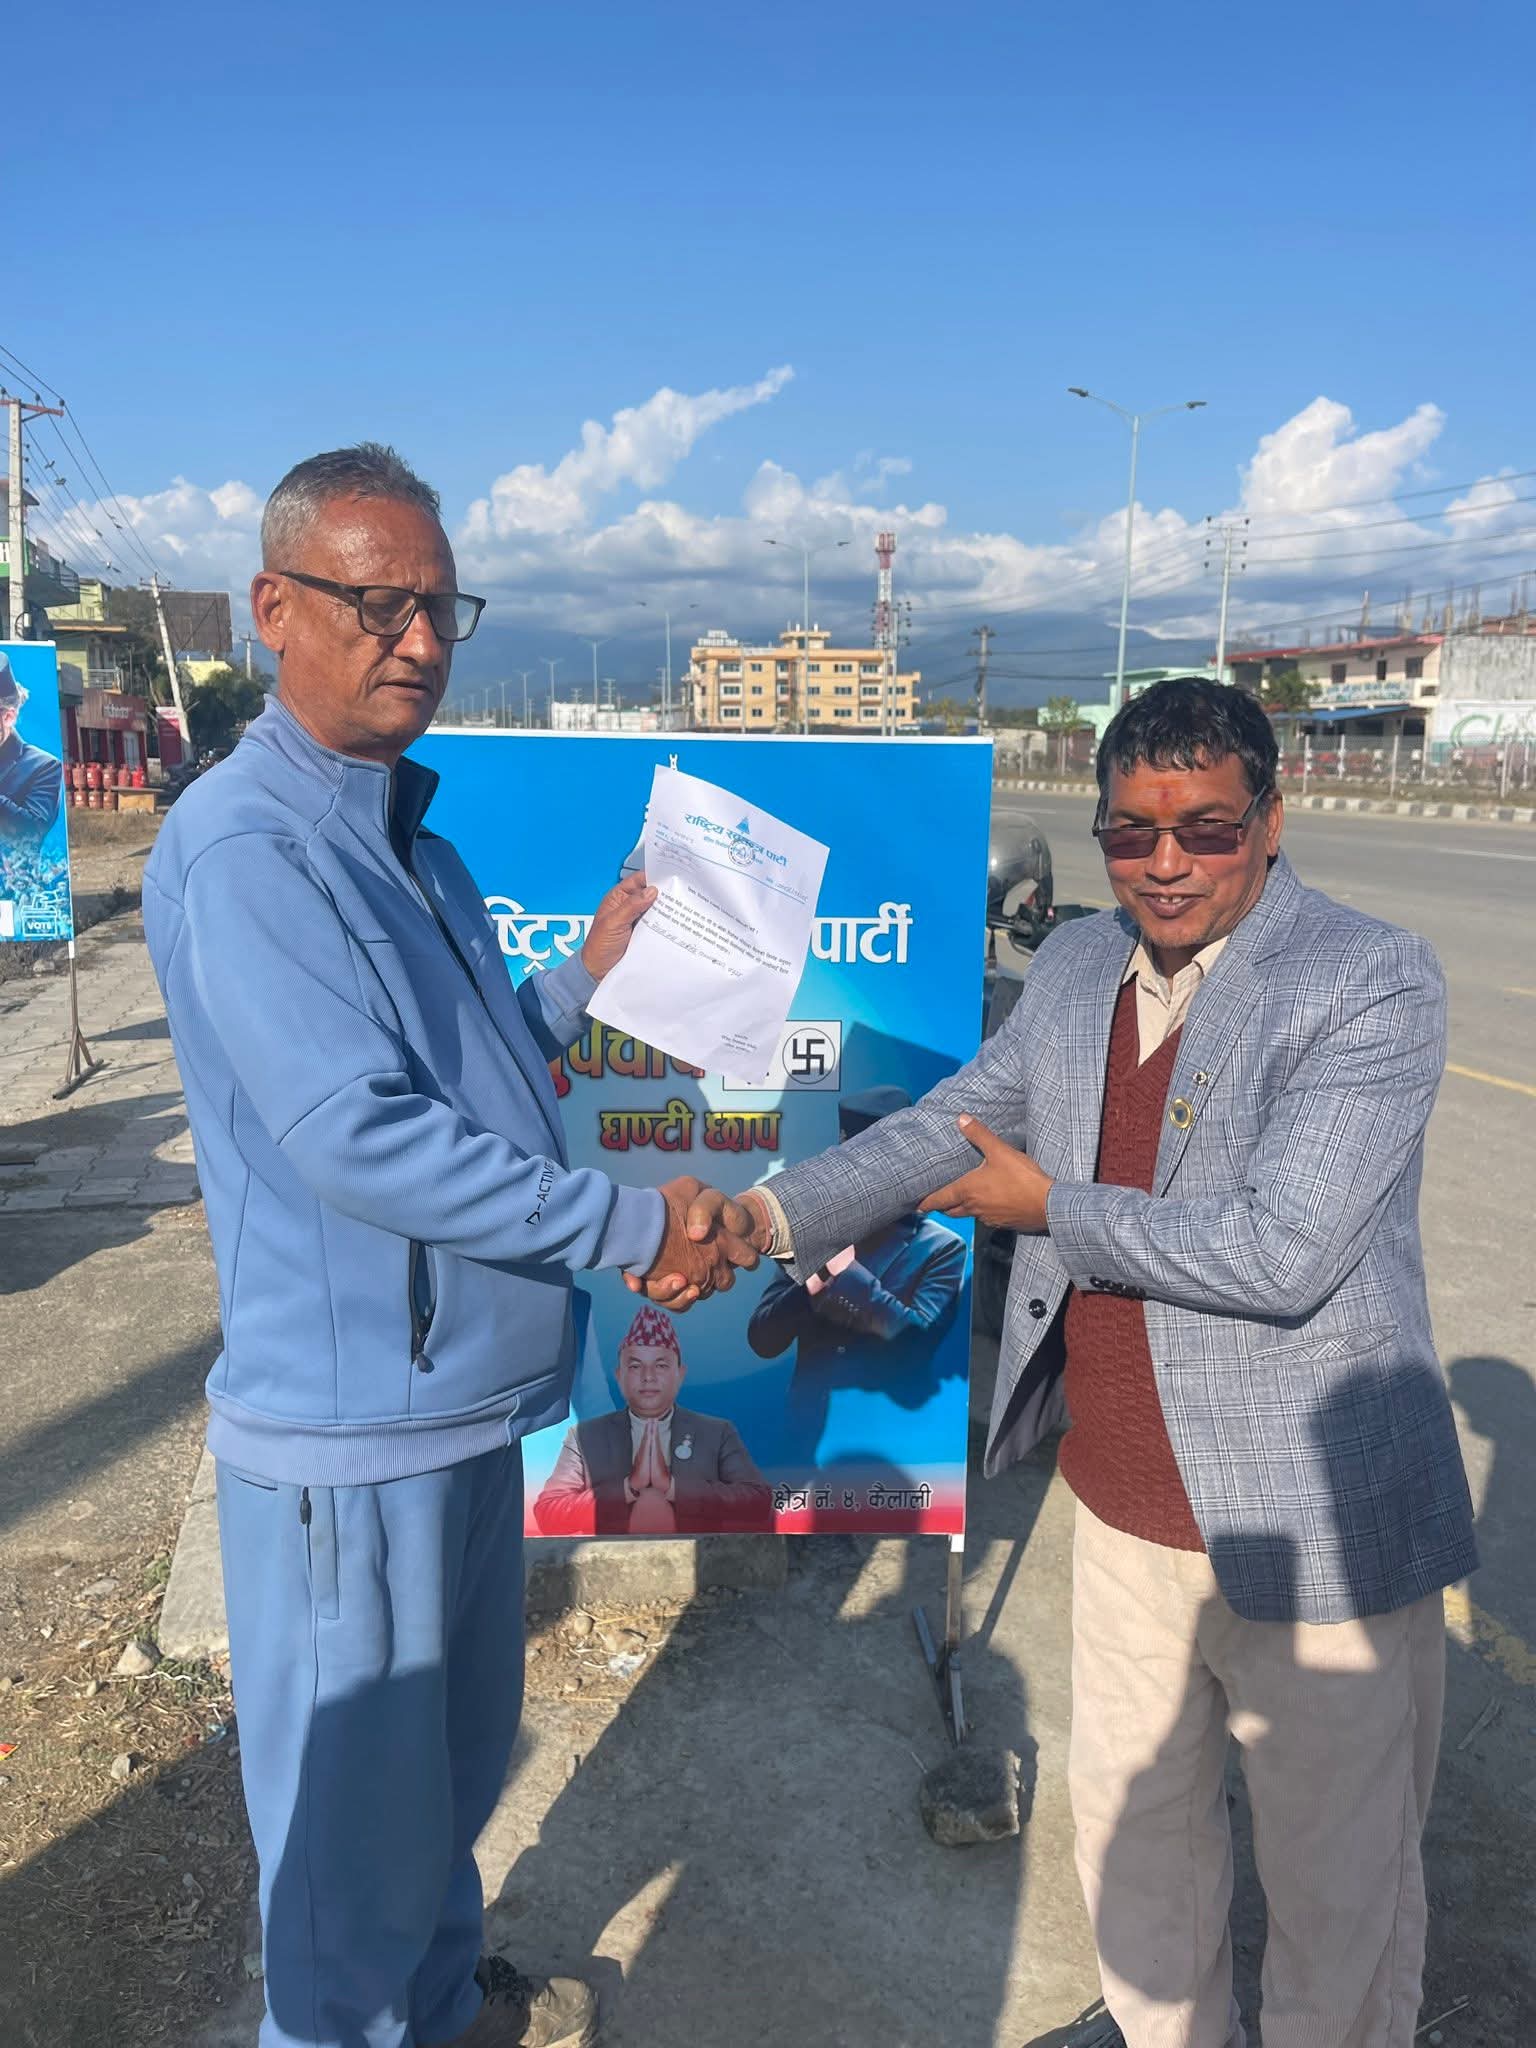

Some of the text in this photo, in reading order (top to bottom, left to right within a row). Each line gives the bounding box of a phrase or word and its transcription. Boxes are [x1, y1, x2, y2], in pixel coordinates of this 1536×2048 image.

[27, 921, 52, 930] VOTE
[811, 901, 914, 964] पार्टी
[600, 1098, 782, 1152] घण्टी छाप
[773, 1481, 810, 1515] क्षेत्र
[814, 1483, 835, 1509] नं.
[867, 1480, 934, 1511] कैलाली
